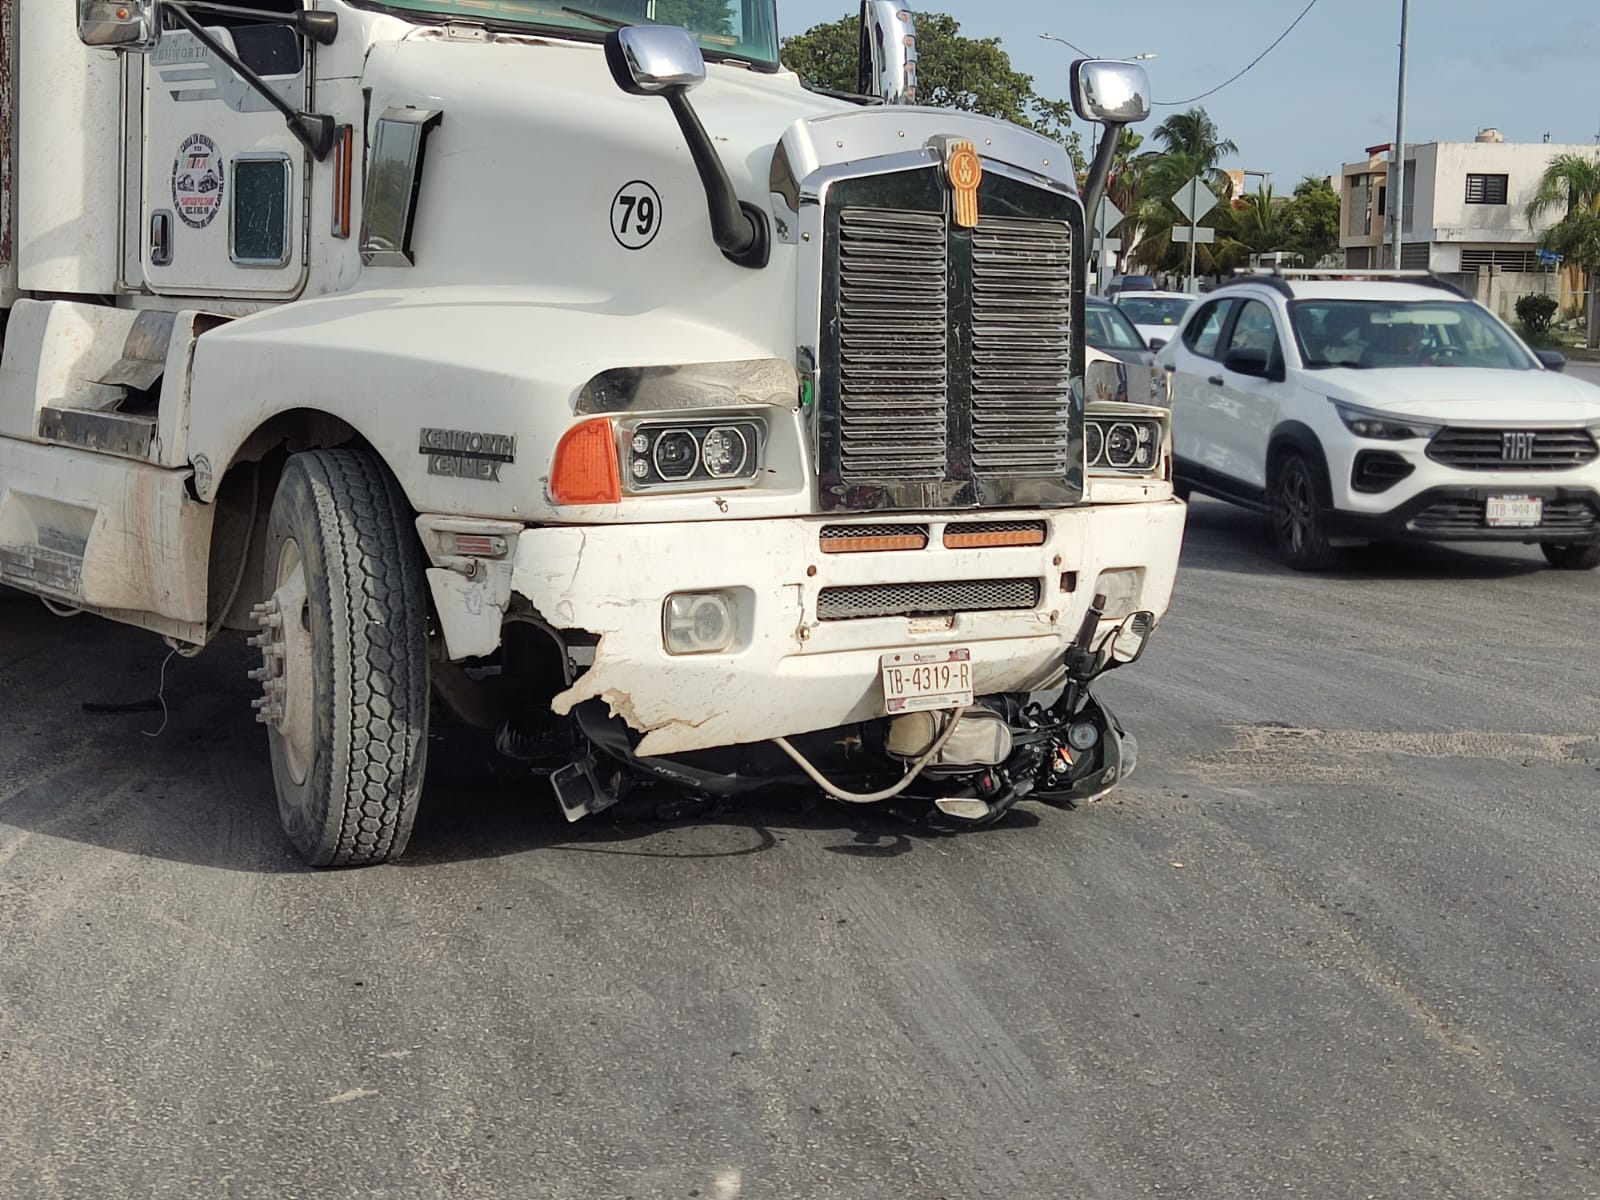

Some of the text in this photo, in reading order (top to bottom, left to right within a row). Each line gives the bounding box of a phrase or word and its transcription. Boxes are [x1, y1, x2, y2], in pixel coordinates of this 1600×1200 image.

[619, 195, 654, 235] 79
[419, 427, 515, 457] KENWORTH
[1502, 432, 1536, 459] FIAT
[427, 454, 502, 483] KENMEX
[887, 663, 969, 695] TB-4319-R
